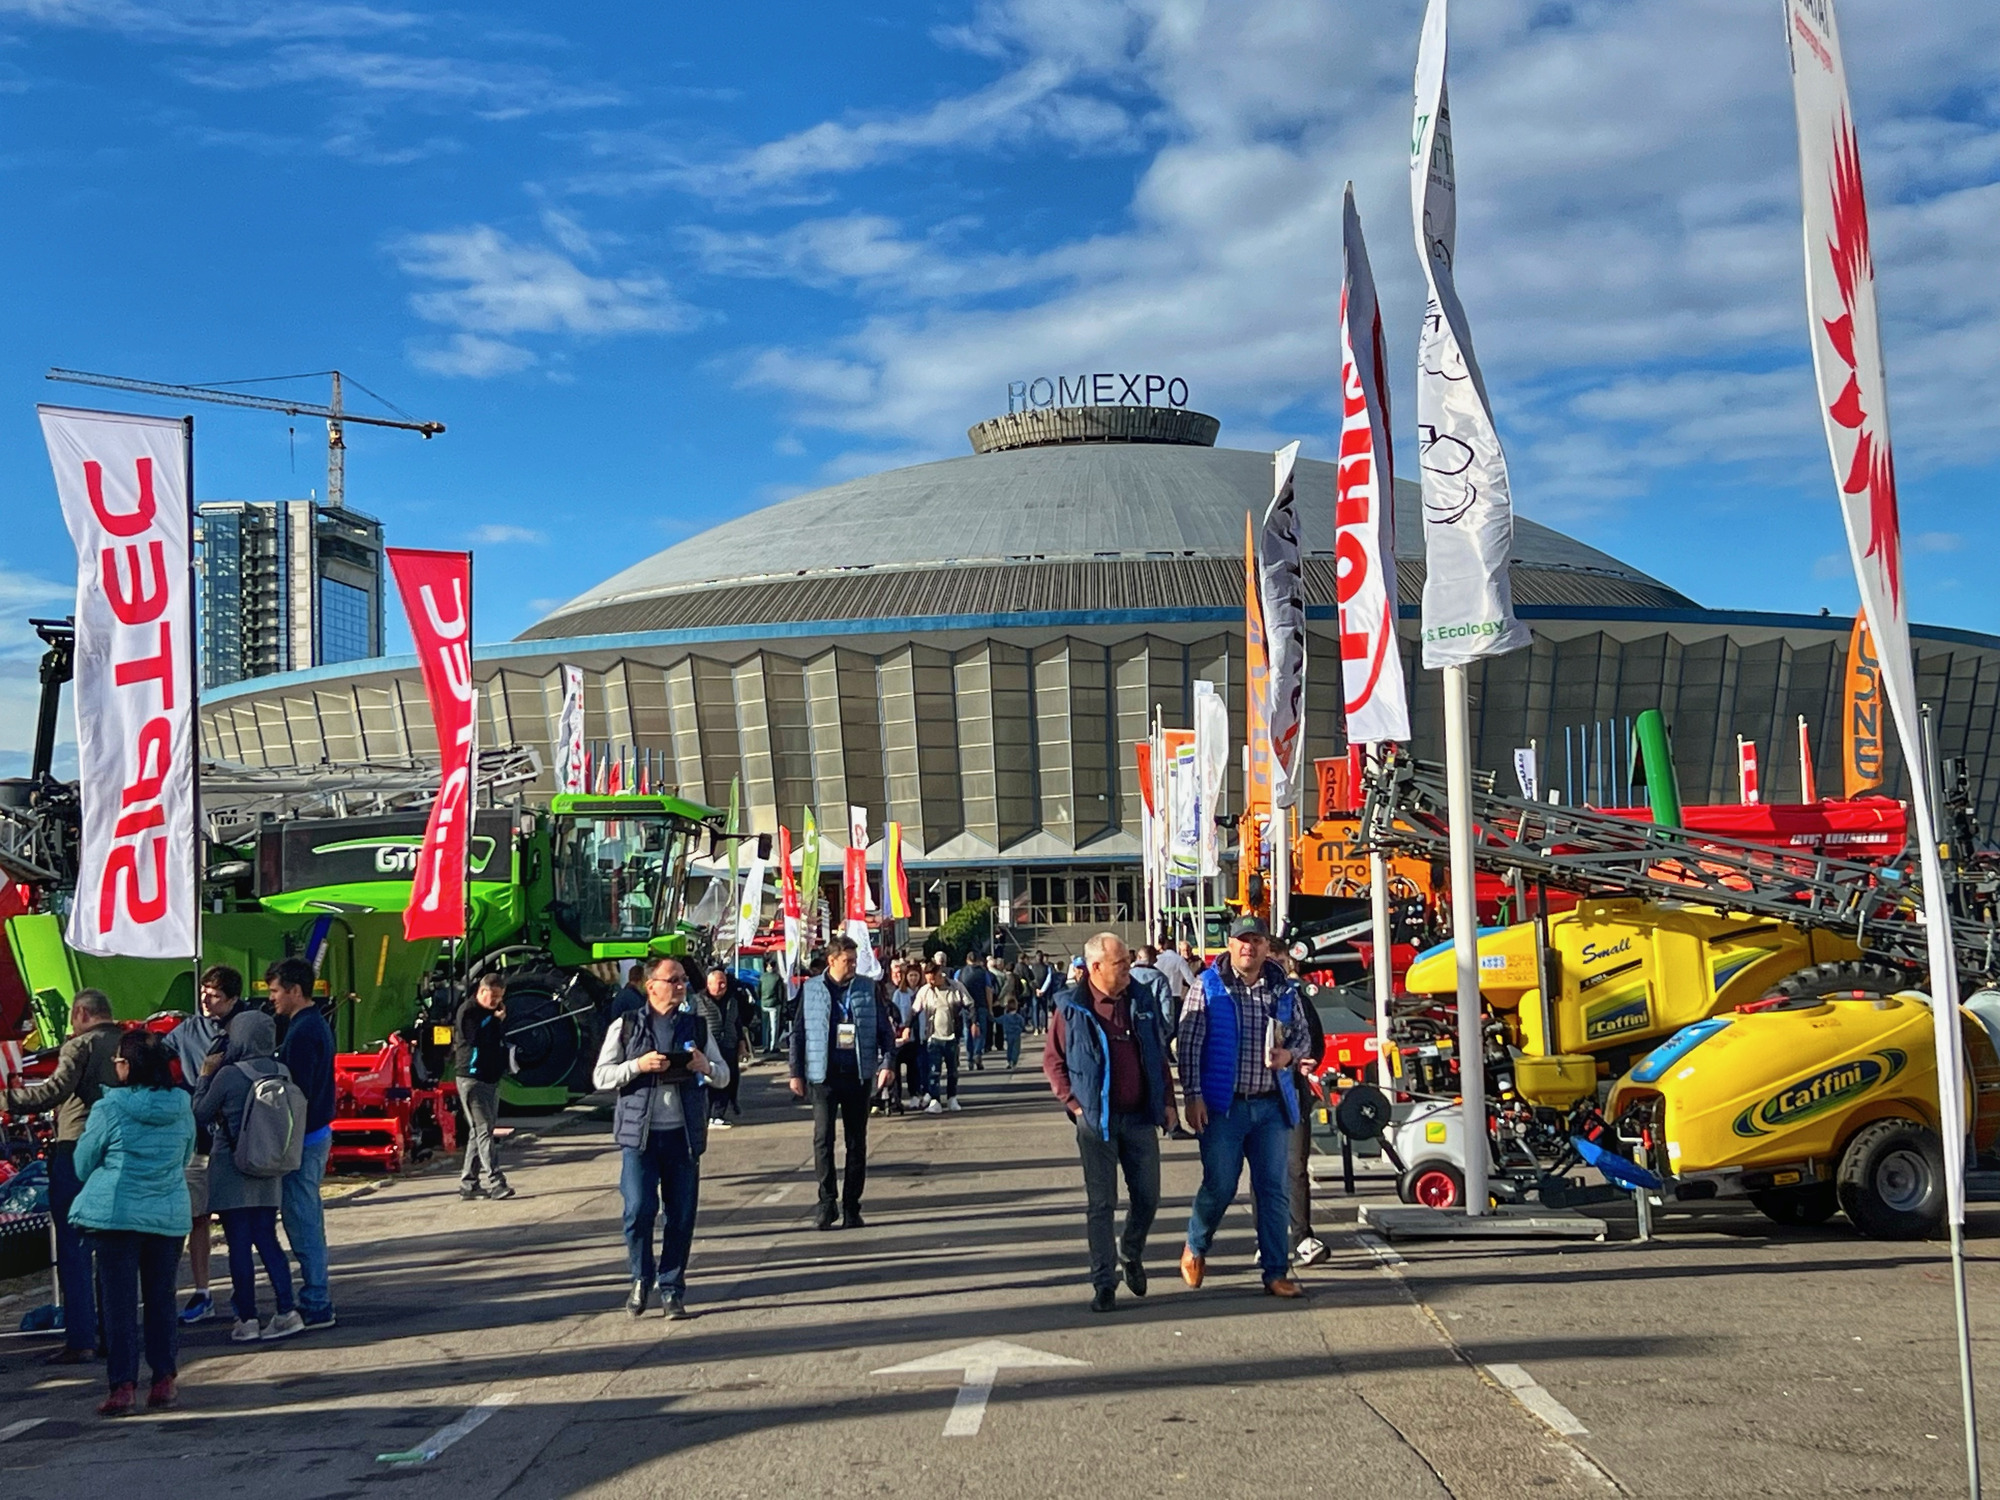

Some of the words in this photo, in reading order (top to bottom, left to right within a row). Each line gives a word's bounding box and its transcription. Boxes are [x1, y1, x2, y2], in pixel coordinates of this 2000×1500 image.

[1007, 373, 1189, 410] ROMEXPO
[1438, 620, 1504, 640] Ecology
[374, 846, 422, 873] Gri
[1582, 937, 1631, 965] Small
[1596, 1011, 1648, 1033] Caffini
[1778, 1062, 1862, 1114] Caffini
